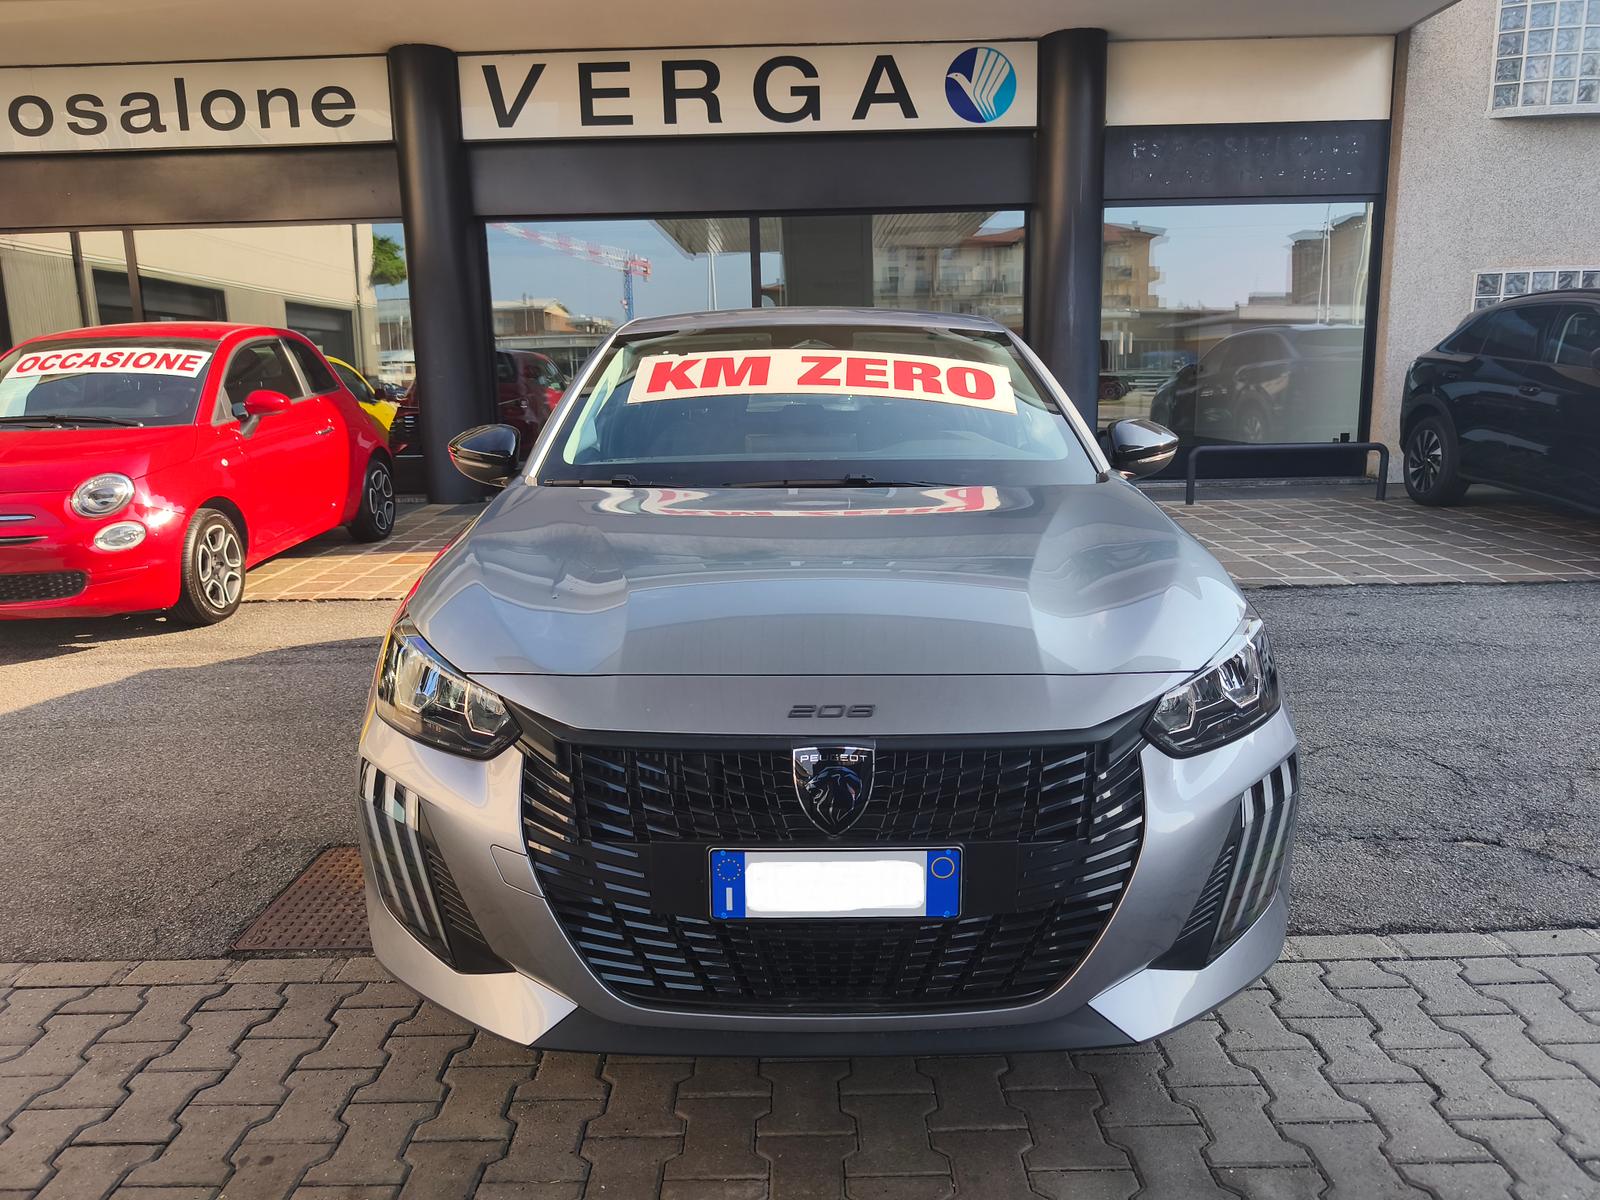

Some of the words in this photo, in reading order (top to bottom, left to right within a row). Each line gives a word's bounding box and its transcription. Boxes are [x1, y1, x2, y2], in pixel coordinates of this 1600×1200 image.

[8, 77, 356, 137] osalone
[481, 54, 919, 128] VERGA
[16, 351, 203, 373] OCCASIONE
[646, 355, 772, 393] KM
[796, 355, 996, 400] ZERO
